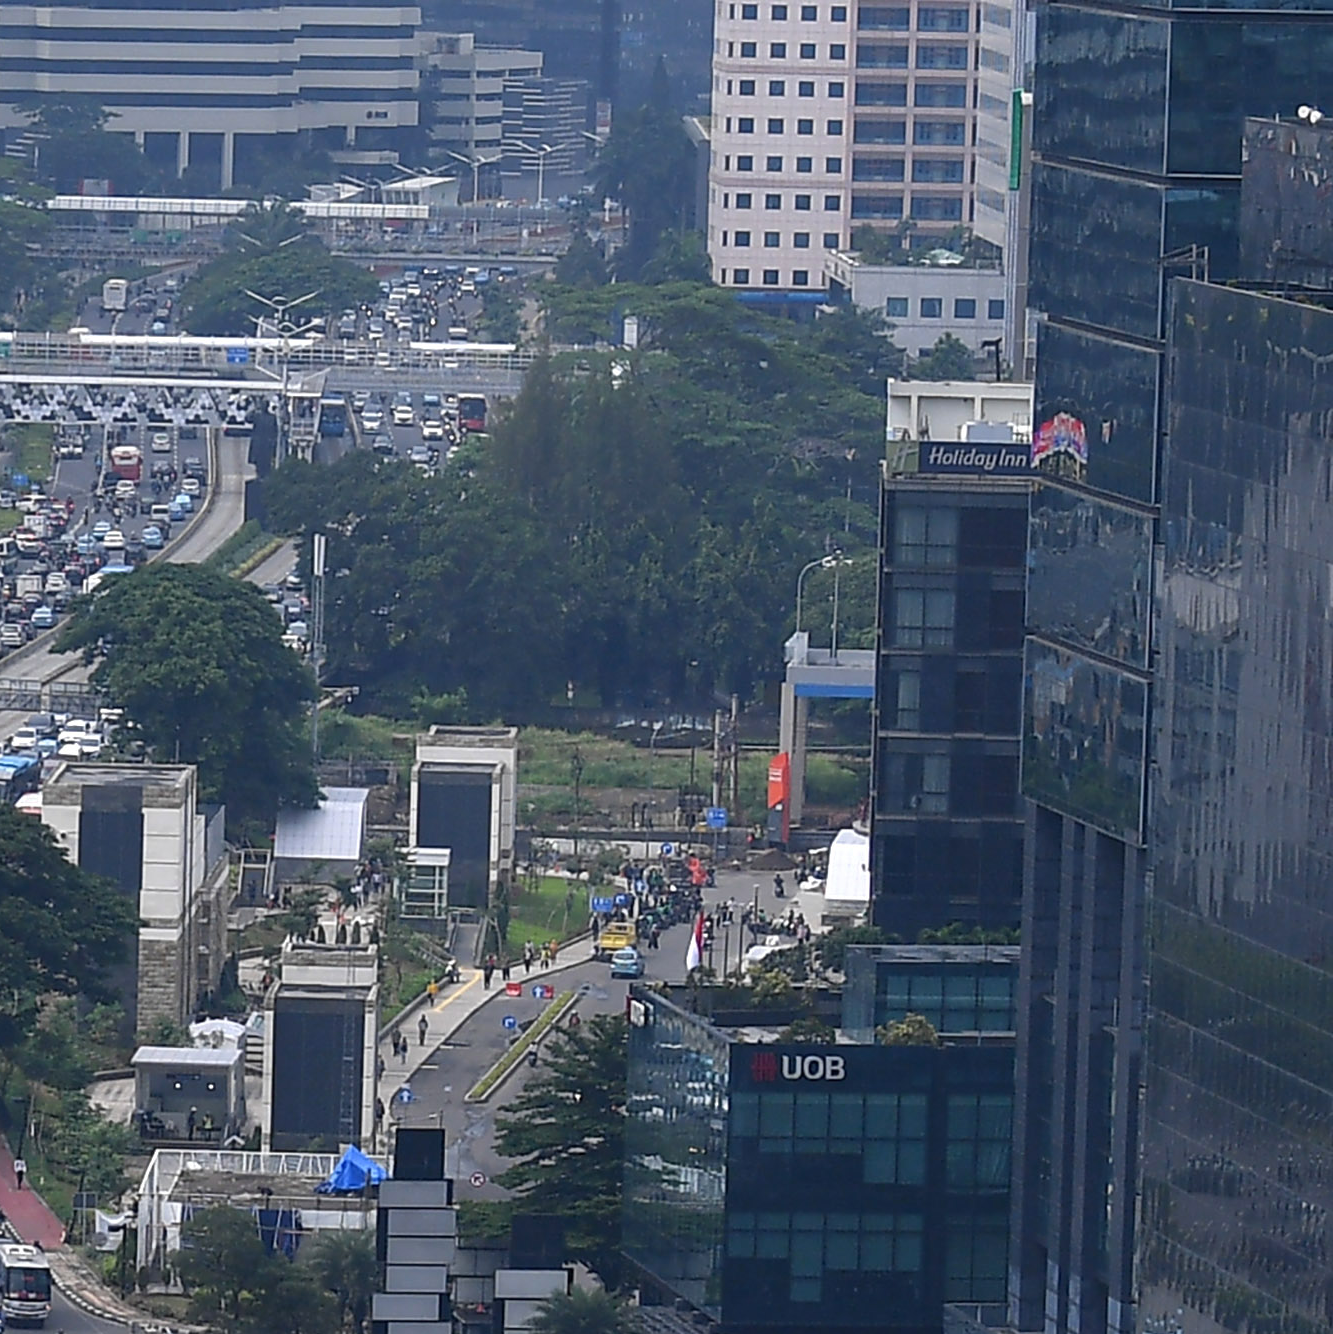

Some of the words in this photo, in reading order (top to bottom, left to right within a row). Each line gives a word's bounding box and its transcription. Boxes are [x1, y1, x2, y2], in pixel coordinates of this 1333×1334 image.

[929, 446, 997, 470] Holiday
[998, 449, 1027, 468] Inn
[781, 1055, 846, 1080] UOB
